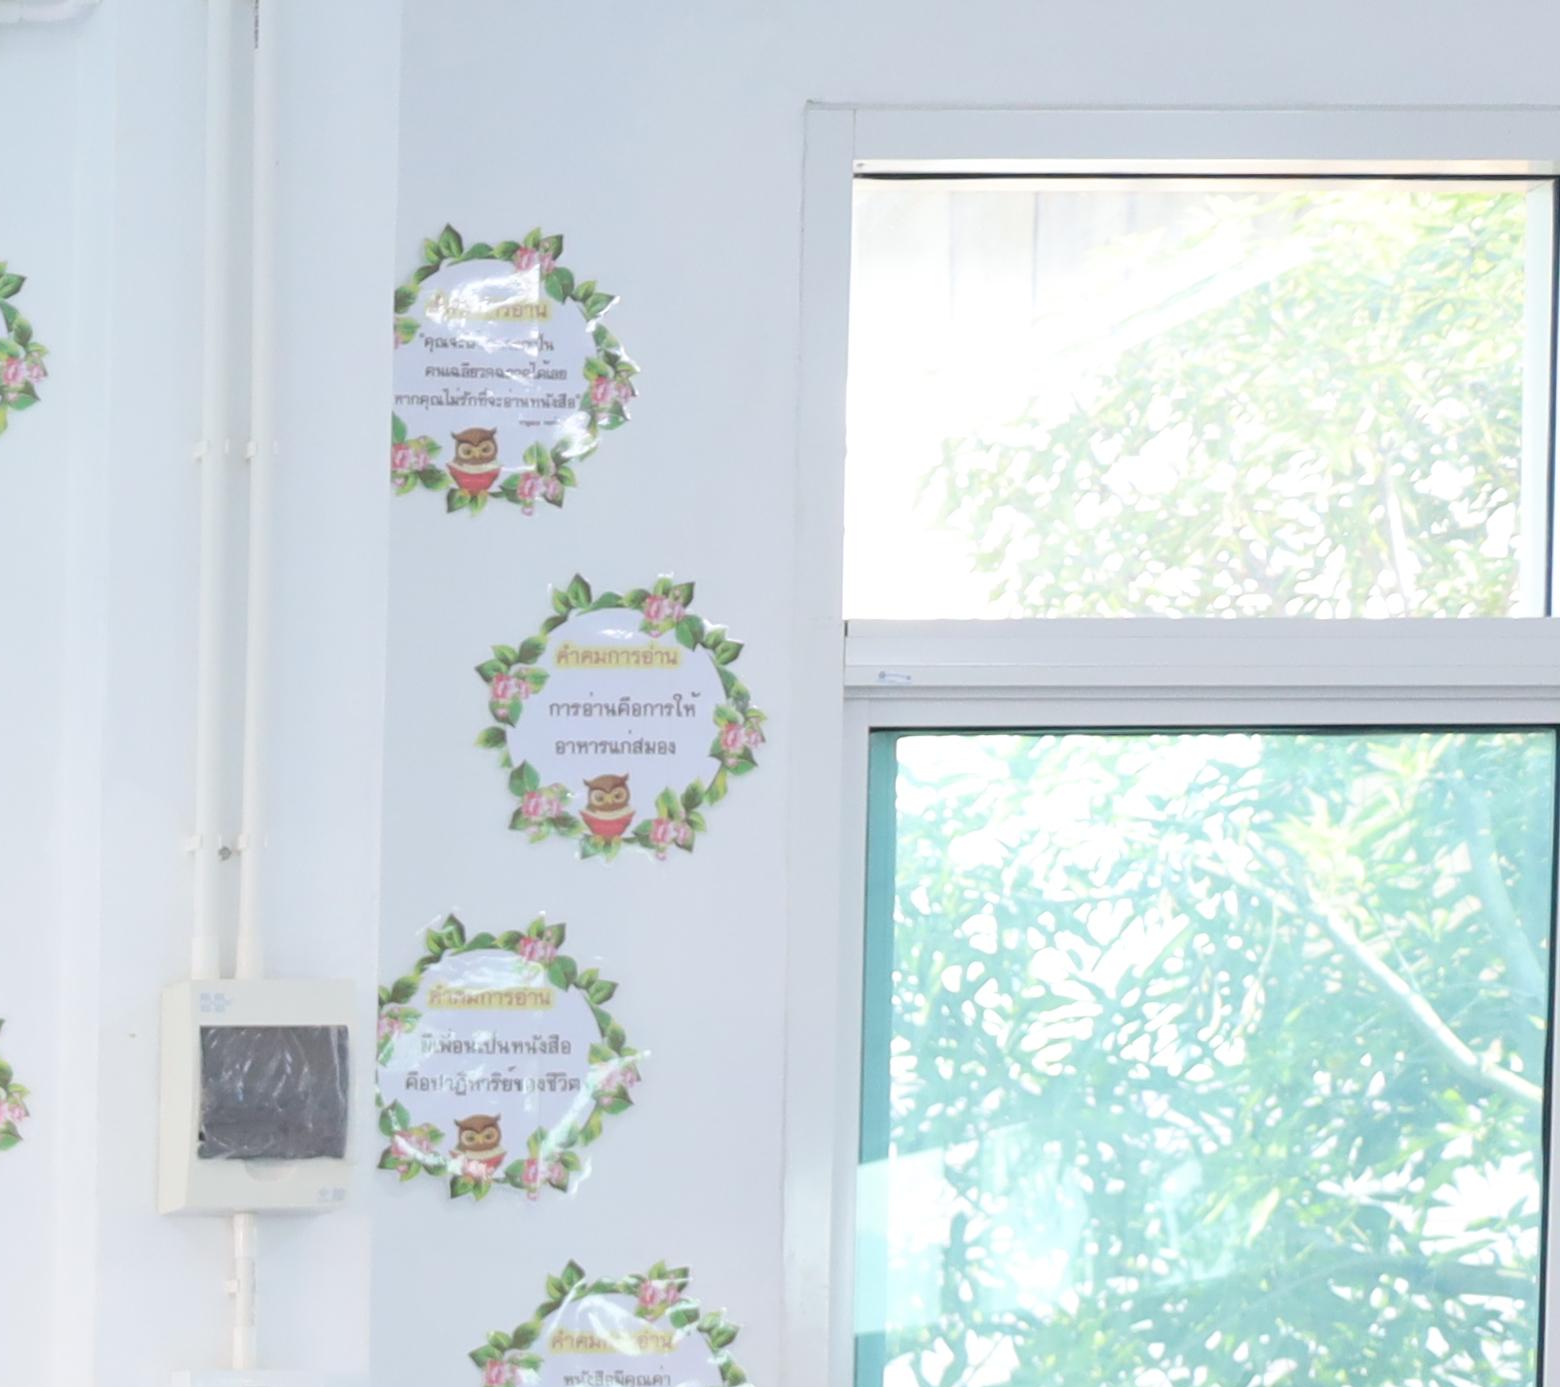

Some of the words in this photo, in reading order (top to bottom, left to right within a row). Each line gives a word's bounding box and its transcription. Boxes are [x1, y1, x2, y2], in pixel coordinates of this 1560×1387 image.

[557, 644, 678, 665] คำคมการอ่าน
[549, 691, 701, 718] การอ่านคือการให้
[555, 730, 676, 755] อาหารแก่สมอง
